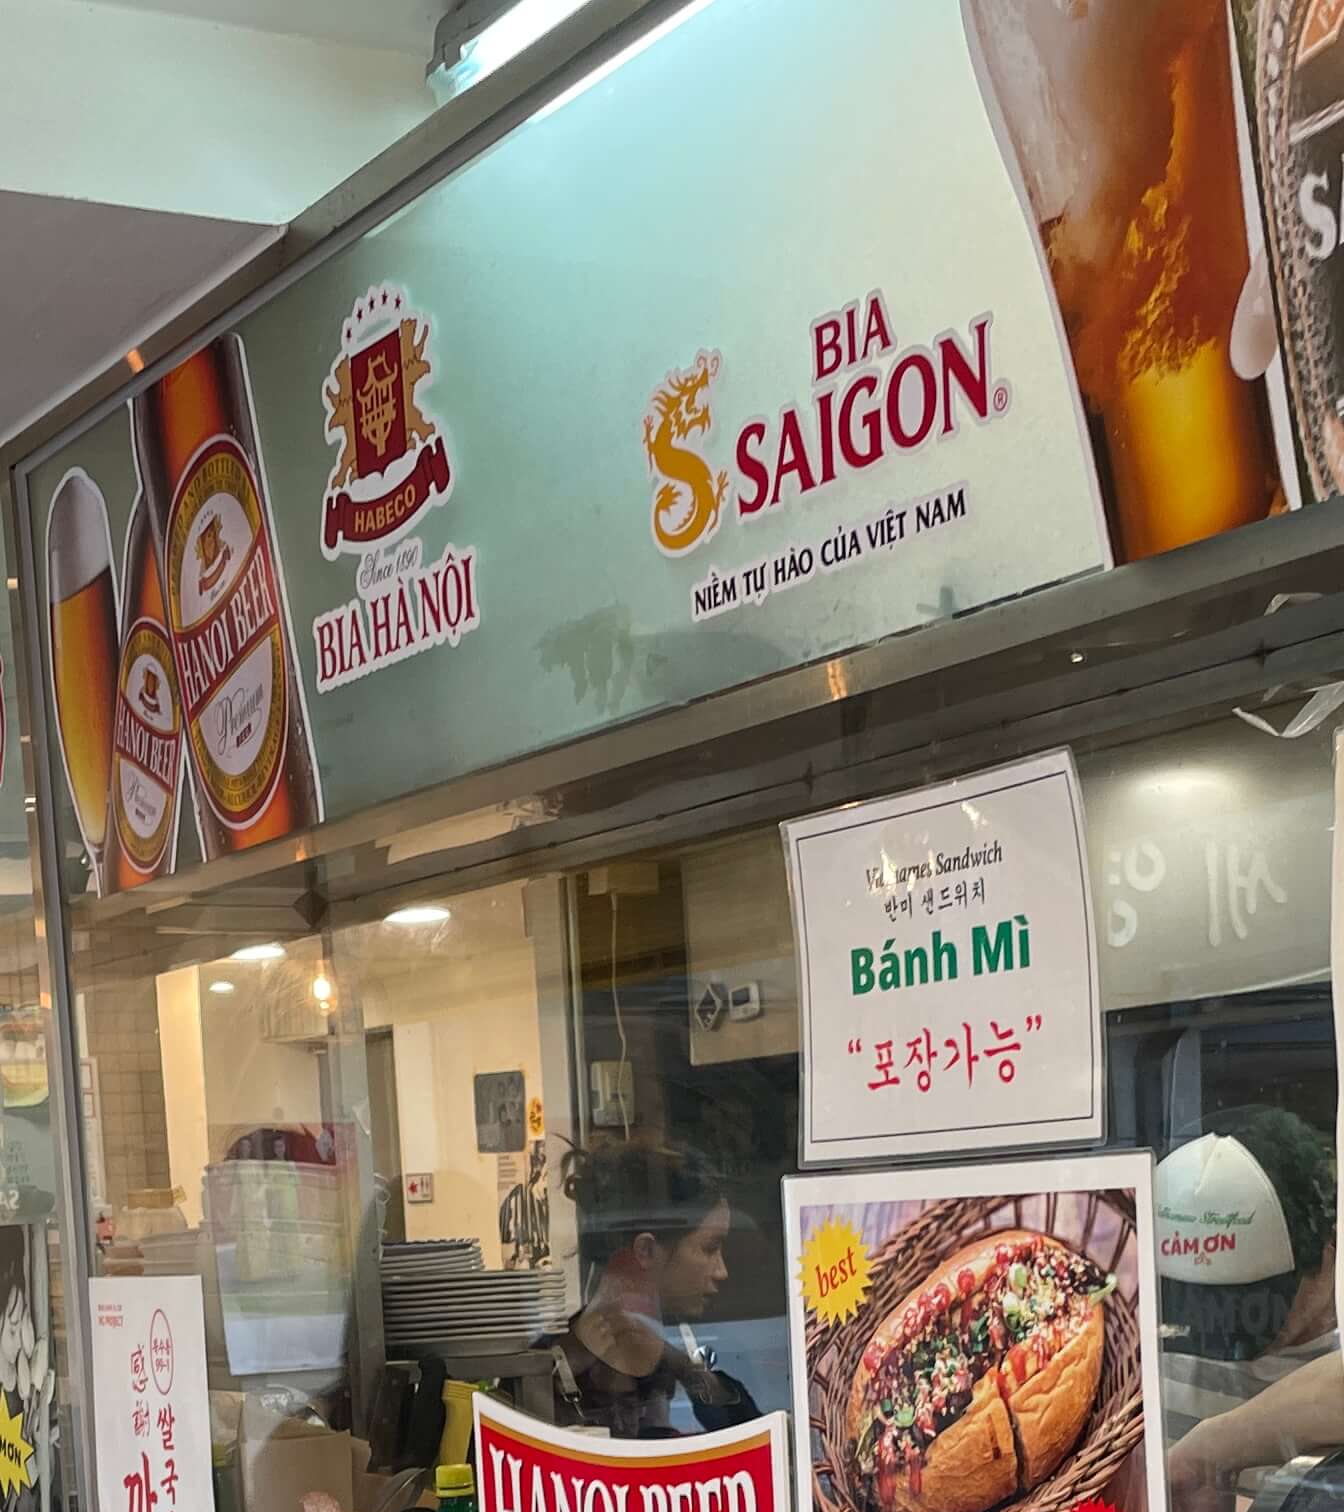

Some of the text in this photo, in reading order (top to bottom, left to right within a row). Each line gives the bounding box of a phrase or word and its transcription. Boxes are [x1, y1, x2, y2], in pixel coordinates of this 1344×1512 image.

[815, 296, 894, 382] BIA
[736, 319, 989, 516] SAIGON
[354, 484, 417, 534] HABECO
[360, 551, 393, 590] Since
[694, 489, 967, 616] NIỀM TỰ HÀO CỦA VIỆT NAM
[178, 546, 275, 707] HANOI BEER
[317, 551, 476, 683] BIA HÀ NỘI
[117, 703, 176, 788] HANOI BEER
[883, 890, 913, 923] 반미
[920, 876, 986, 915] 샌드위치
[935, 839, 1003, 876] Sandwich
[849, 914, 1031, 997] Bánh Mì
[815, 1246, 858, 1299] best
